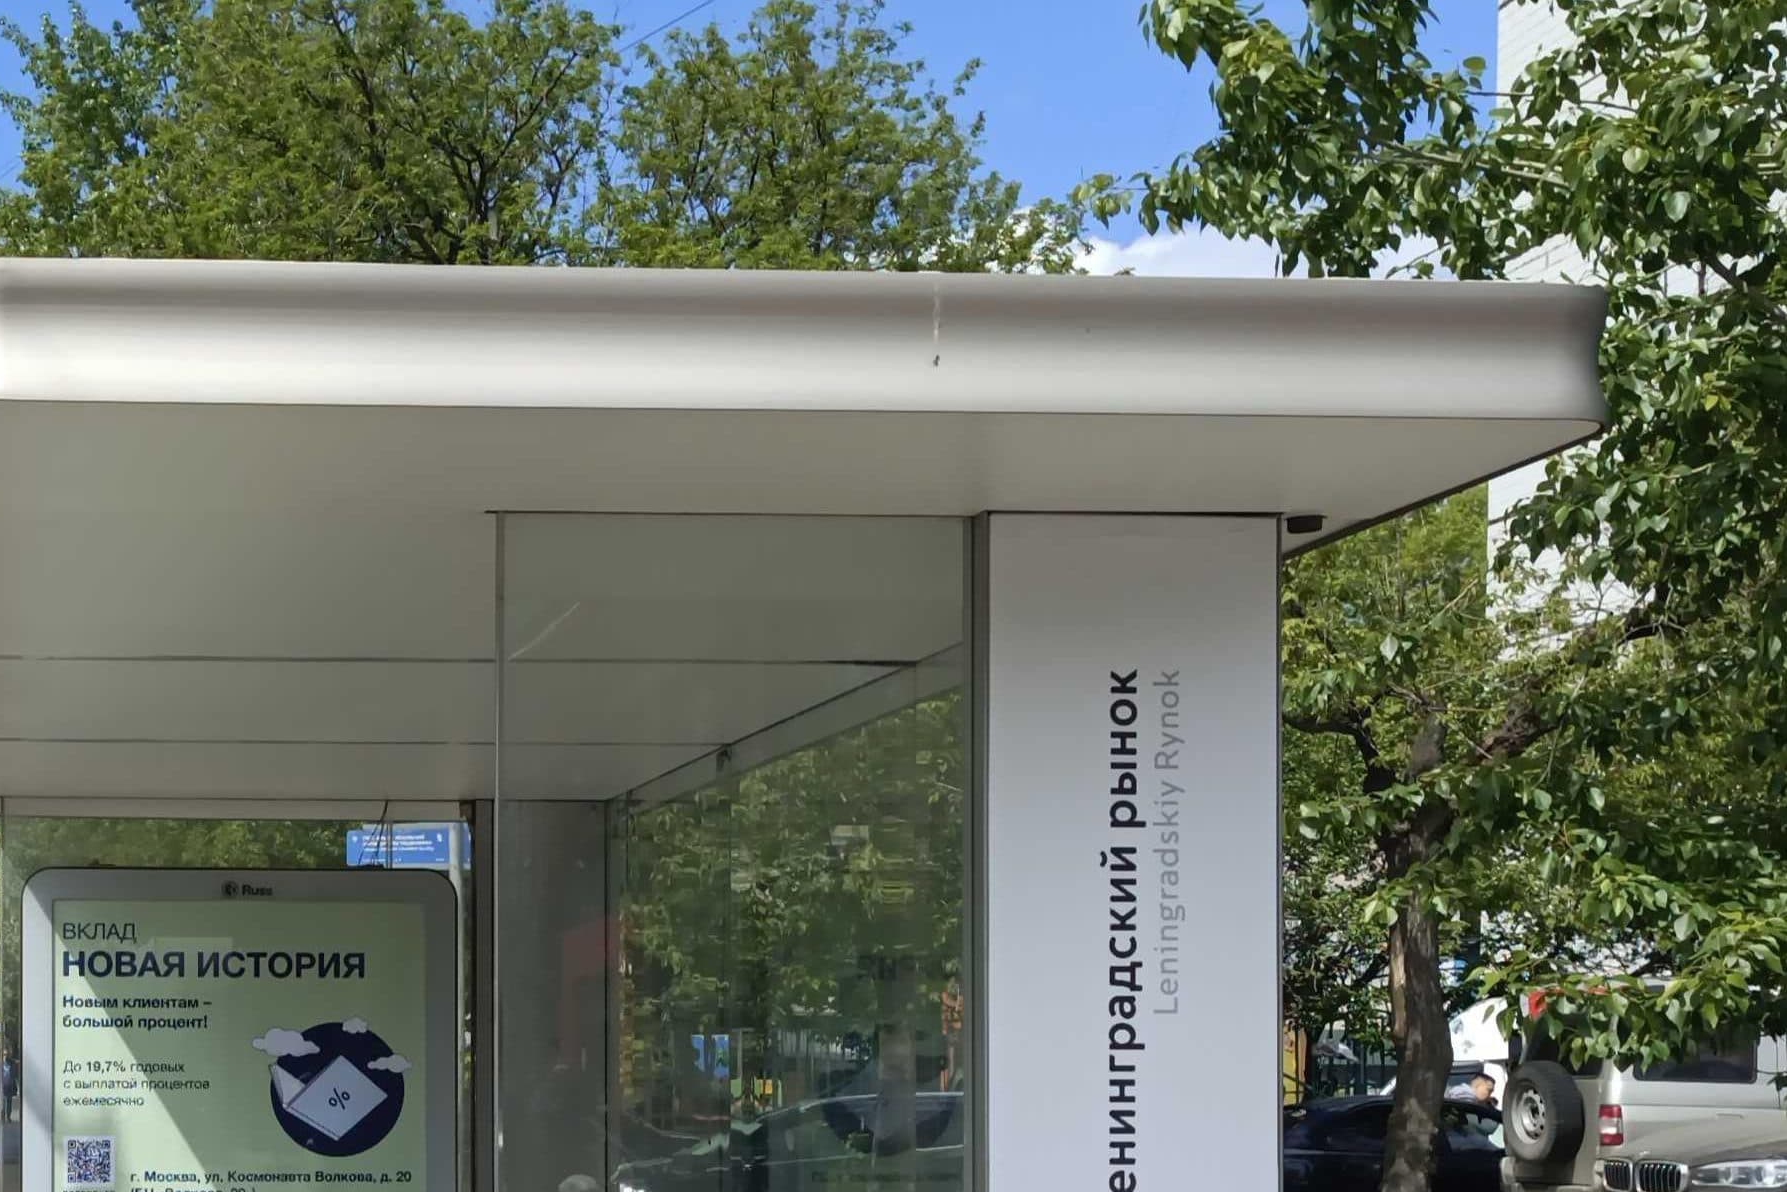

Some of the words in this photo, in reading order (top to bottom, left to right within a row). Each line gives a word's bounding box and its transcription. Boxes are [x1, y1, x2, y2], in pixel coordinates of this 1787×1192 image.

[1153, 671, 1185, 770] Rynok
[1109, 669, 1147, 829] рынок
[1153, 780, 1185, 1015] Leningradskiy
[62, 922, 138, 944] ВКЛАД
[62, 951, 185, 978] НОВАЯ
[197, 951, 366, 979] ИСТОРИЯ
[62, 996, 118, 1009] Новым
[123, 998, 199, 1009] клиентам
[62, 1015, 133, 1028] большой
[138, 1015, 208, 1031] процент!
[63, 1061, 82, 1074] До
[86, 1061, 126, 1074] 19,7%
[130, 1062, 184, 1075] годовых
[75, 1076, 137, 1090] выплатой
[141, 1079, 210, 1091] процентов
[63, 1096, 144, 1107] ежемесячно
[328, 1087, 351, 1110] %
[144, 1171, 201, 1184] Москва,
[228, 1171, 311, 1183] Космонавта
[315, 1171, 377, 1184] Волкова,
[396, 1171, 412, 1183] 20
